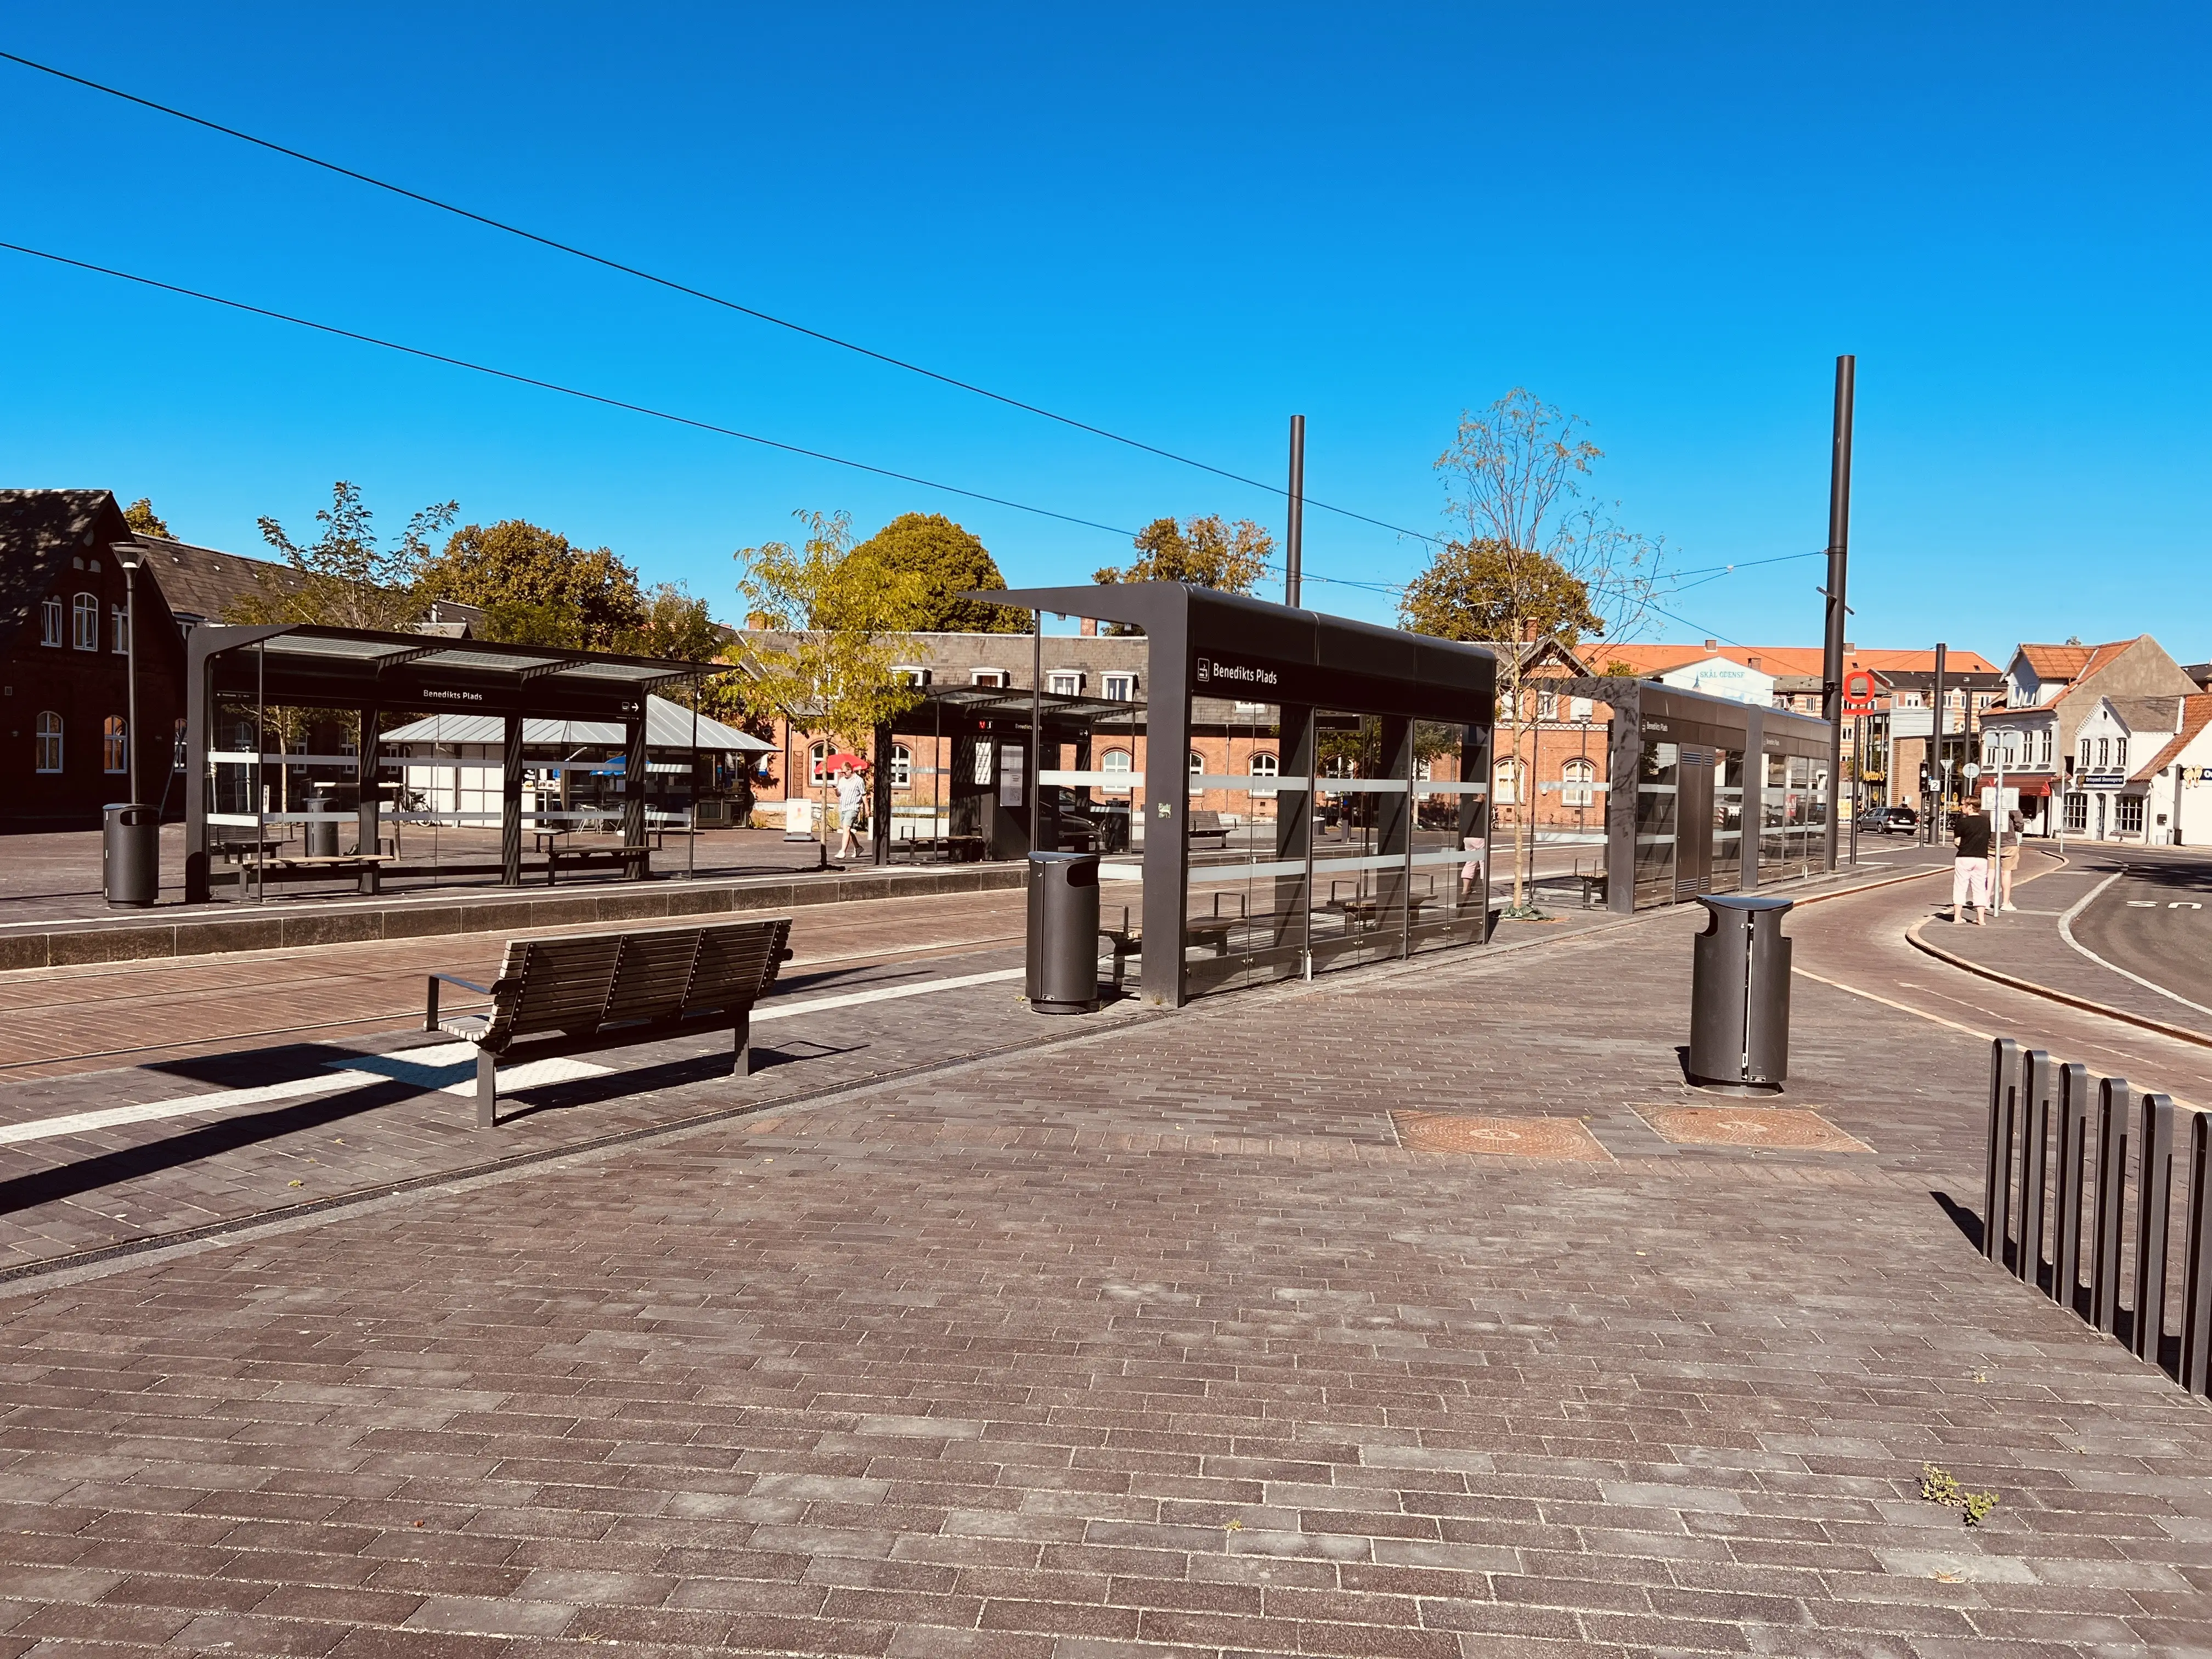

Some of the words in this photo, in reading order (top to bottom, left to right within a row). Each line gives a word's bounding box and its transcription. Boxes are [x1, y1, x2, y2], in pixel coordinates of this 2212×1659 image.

[1214, 663, 1254, 681] Benedikts
[1256, 669, 1277, 685] Plads
[1700, 669, 1717, 678] SKÅL
[424, 690, 461, 699] Benedikts
[462, 692, 482, 701] Plads
[1864, 770, 1879, 782] Netto
